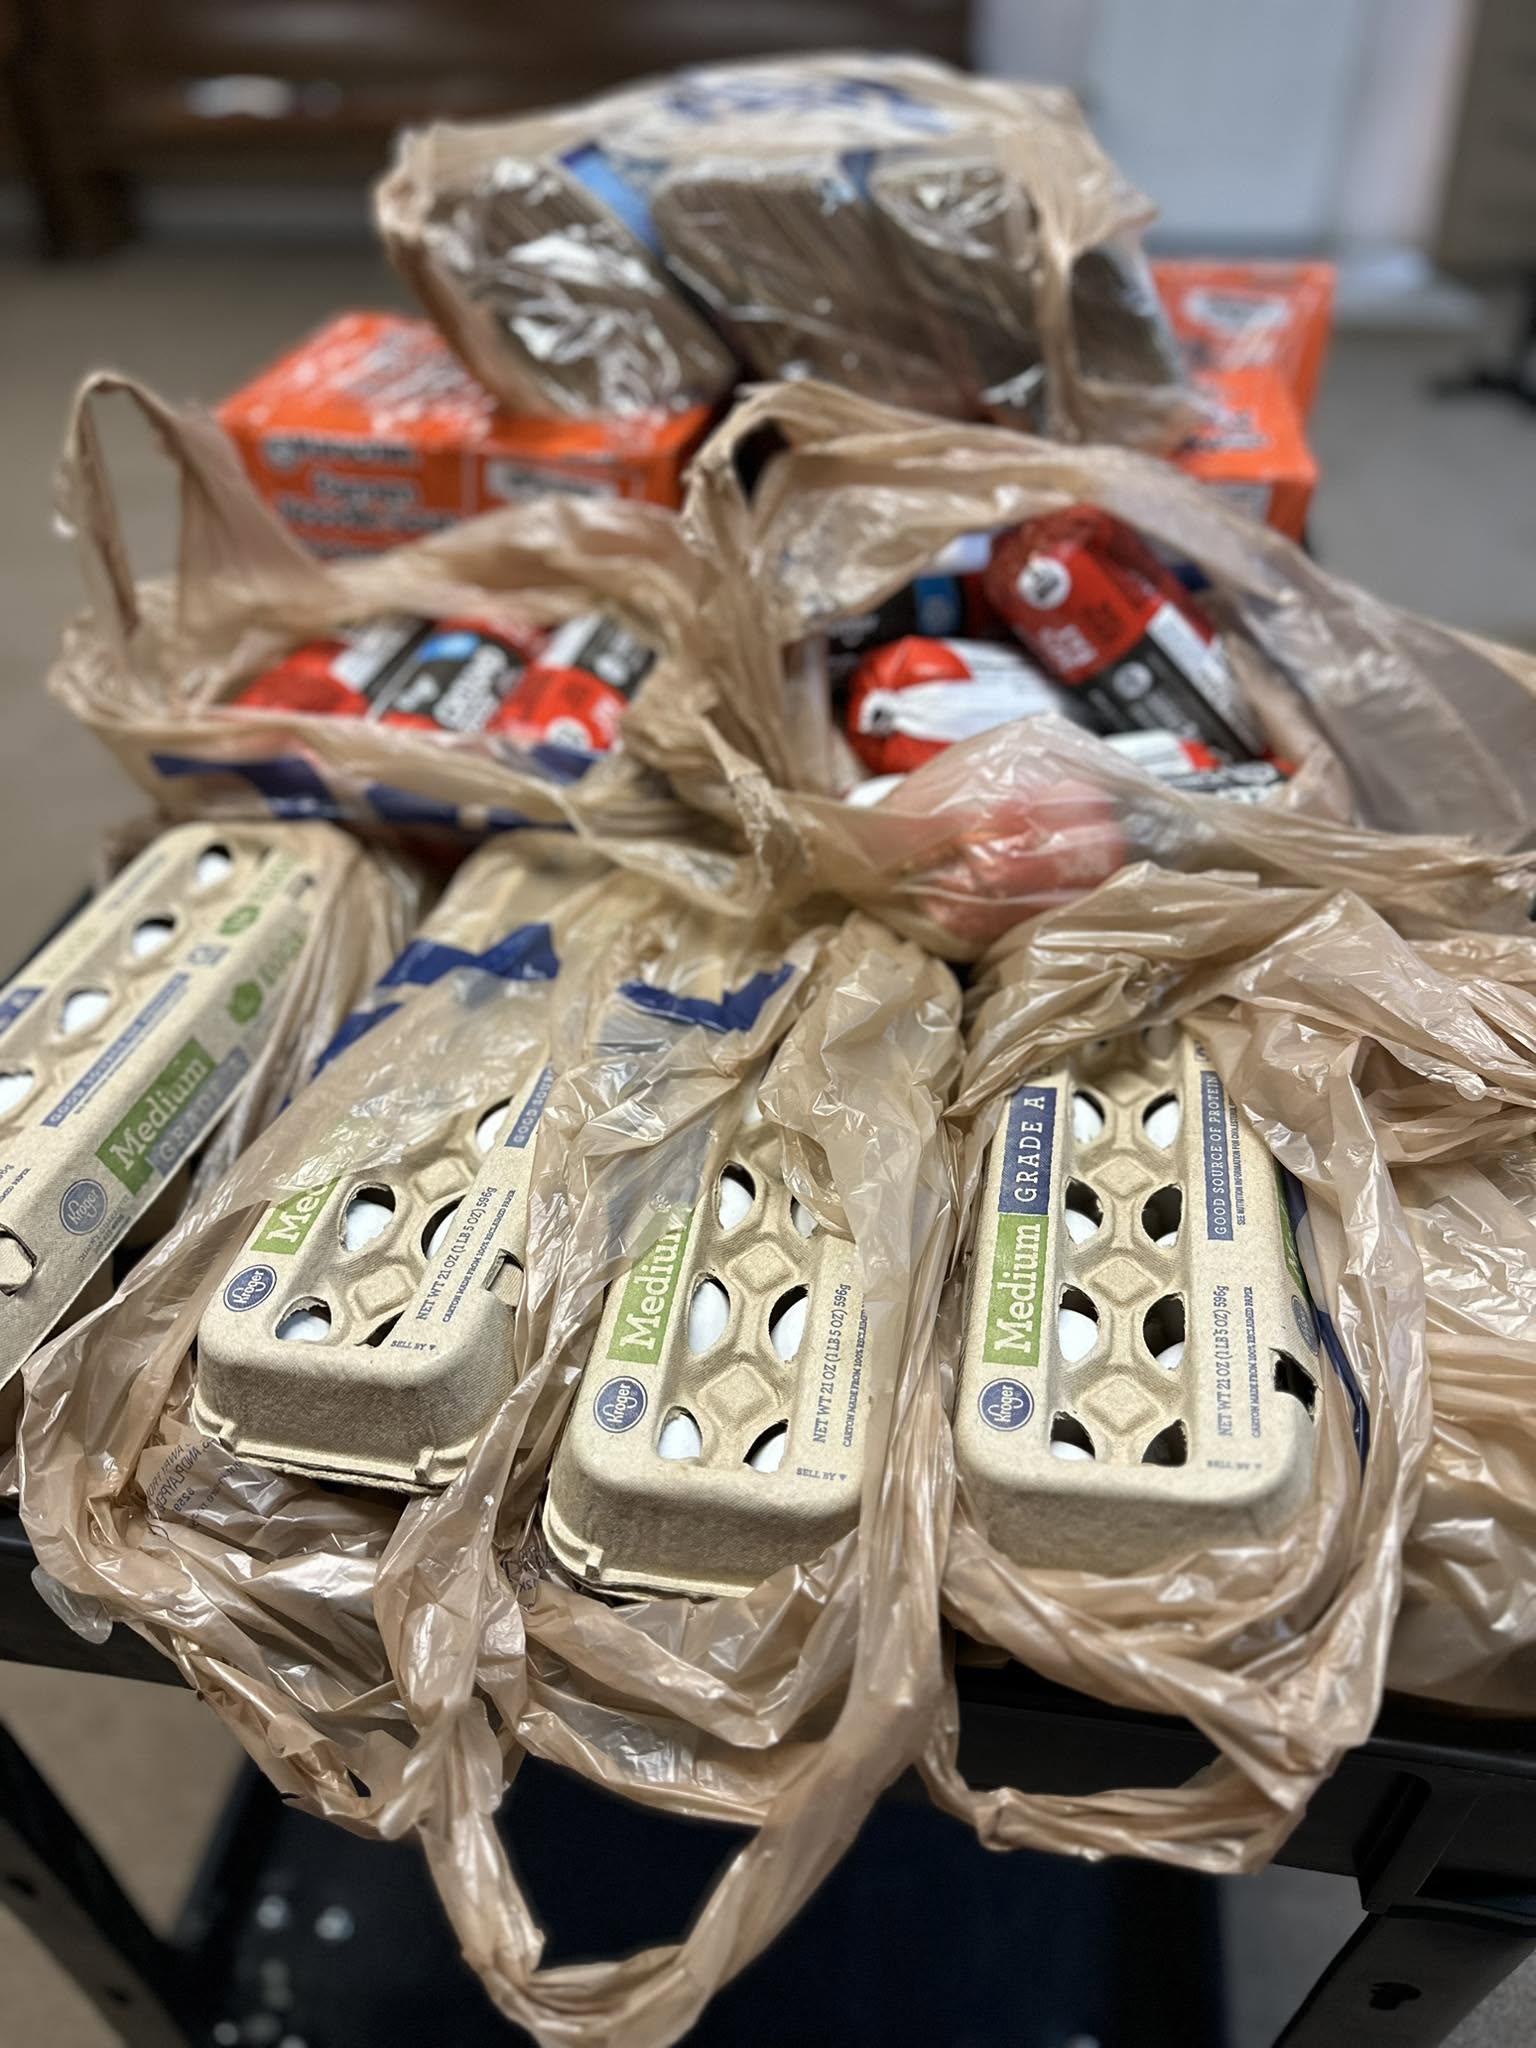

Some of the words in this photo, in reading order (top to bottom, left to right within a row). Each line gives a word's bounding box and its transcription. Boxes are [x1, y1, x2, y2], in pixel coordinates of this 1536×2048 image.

[1023, 1096, 1046, 1110] A
[1206, 1075, 1221, 1123] PROTEIN
[108, 1059, 208, 1172] Medium
[513, 1109, 538, 1143] GOOD
[1209, 1125, 1222, 1142] OF
[1014, 1121, 1044, 1203] GRADE
[1210, 1144, 1225, 1194] SOURCE
[67, 1188, 99, 1226] Kroger
[476, 1186, 498, 1209] 596g
[467, 1206, 487, 1228] OZ)
[1213, 1198, 1227, 1235] GOOD
[1238, 1213, 1246, 1226] SEE
[458, 1231, 472, 1248] LB
[463, 1224, 475, 1233] 5
[442, 1294, 461, 1323] CARTON
[456, 1275, 470, 1296] MADE
[464, 1254, 482, 1277] FROM
[474, 1236, 491, 1257] 100%
[500, 1189, 517, 1211] PAPER
[451, 1242, 467, 1258] (1
[443, 1253, 460, 1272] OZ
[438, 1267, 452, 1284] 21
[231, 1270, 267, 1304] Kroger
[429, 1280, 446, 1300] WT
[834, 1283, 851, 1309] 596g
[993, 1223, 1041, 1354] Medium
[1213, 1285, 1229, 1309] 596g
[1244, 1286, 1253, 1306] PAPER
[416, 1296, 435, 1321] NET
[831, 1309, 848, 1329] OZ)
[1214, 1308, 1231, 1328] OZ)
[832, 1328, 842, 1337] 5
[1215, 1334, 1229, 1350] LB
[1216, 1327, 1228, 1335] 5
[391, 1340, 412, 1350] SELL
[414, 1342, 426, 1351] BY
[830, 1336, 841, 1353] LB
[824, 1351, 841, 1364] (1
[853, 1347, 864, 1368] 100%
[1214, 1349, 1233, 1363] (1
[822, 1363, 837, 1381] OZ
[851, 1368, 861, 1392] FROM
[1216, 1361, 1230, 1378] OZ
[1248, 1362, 1258, 1384] FROM
[820, 1380, 834, 1397] 21
[1216, 1378, 1231, 1392] 21
[1249, 1384, 1259, 1407] MADE
[602, 1383, 638, 1424] Kroger
[817, 1395, 832, 1420] WT
[848, 1391, 859, 1417] MADE
[988, 1384, 1024, 1423] Kroger
[1217, 1391, 1231, 1413] WT
[813, 1418, 828, 1444] NET
[842, 1416, 856, 1447] CARTON
[1217, 1412, 1233, 1437] NET
[1250, 1406, 1261, 1438] CARTON
[796, 1467, 821, 1480] SELL
[823, 1471, 836, 1481] BY
